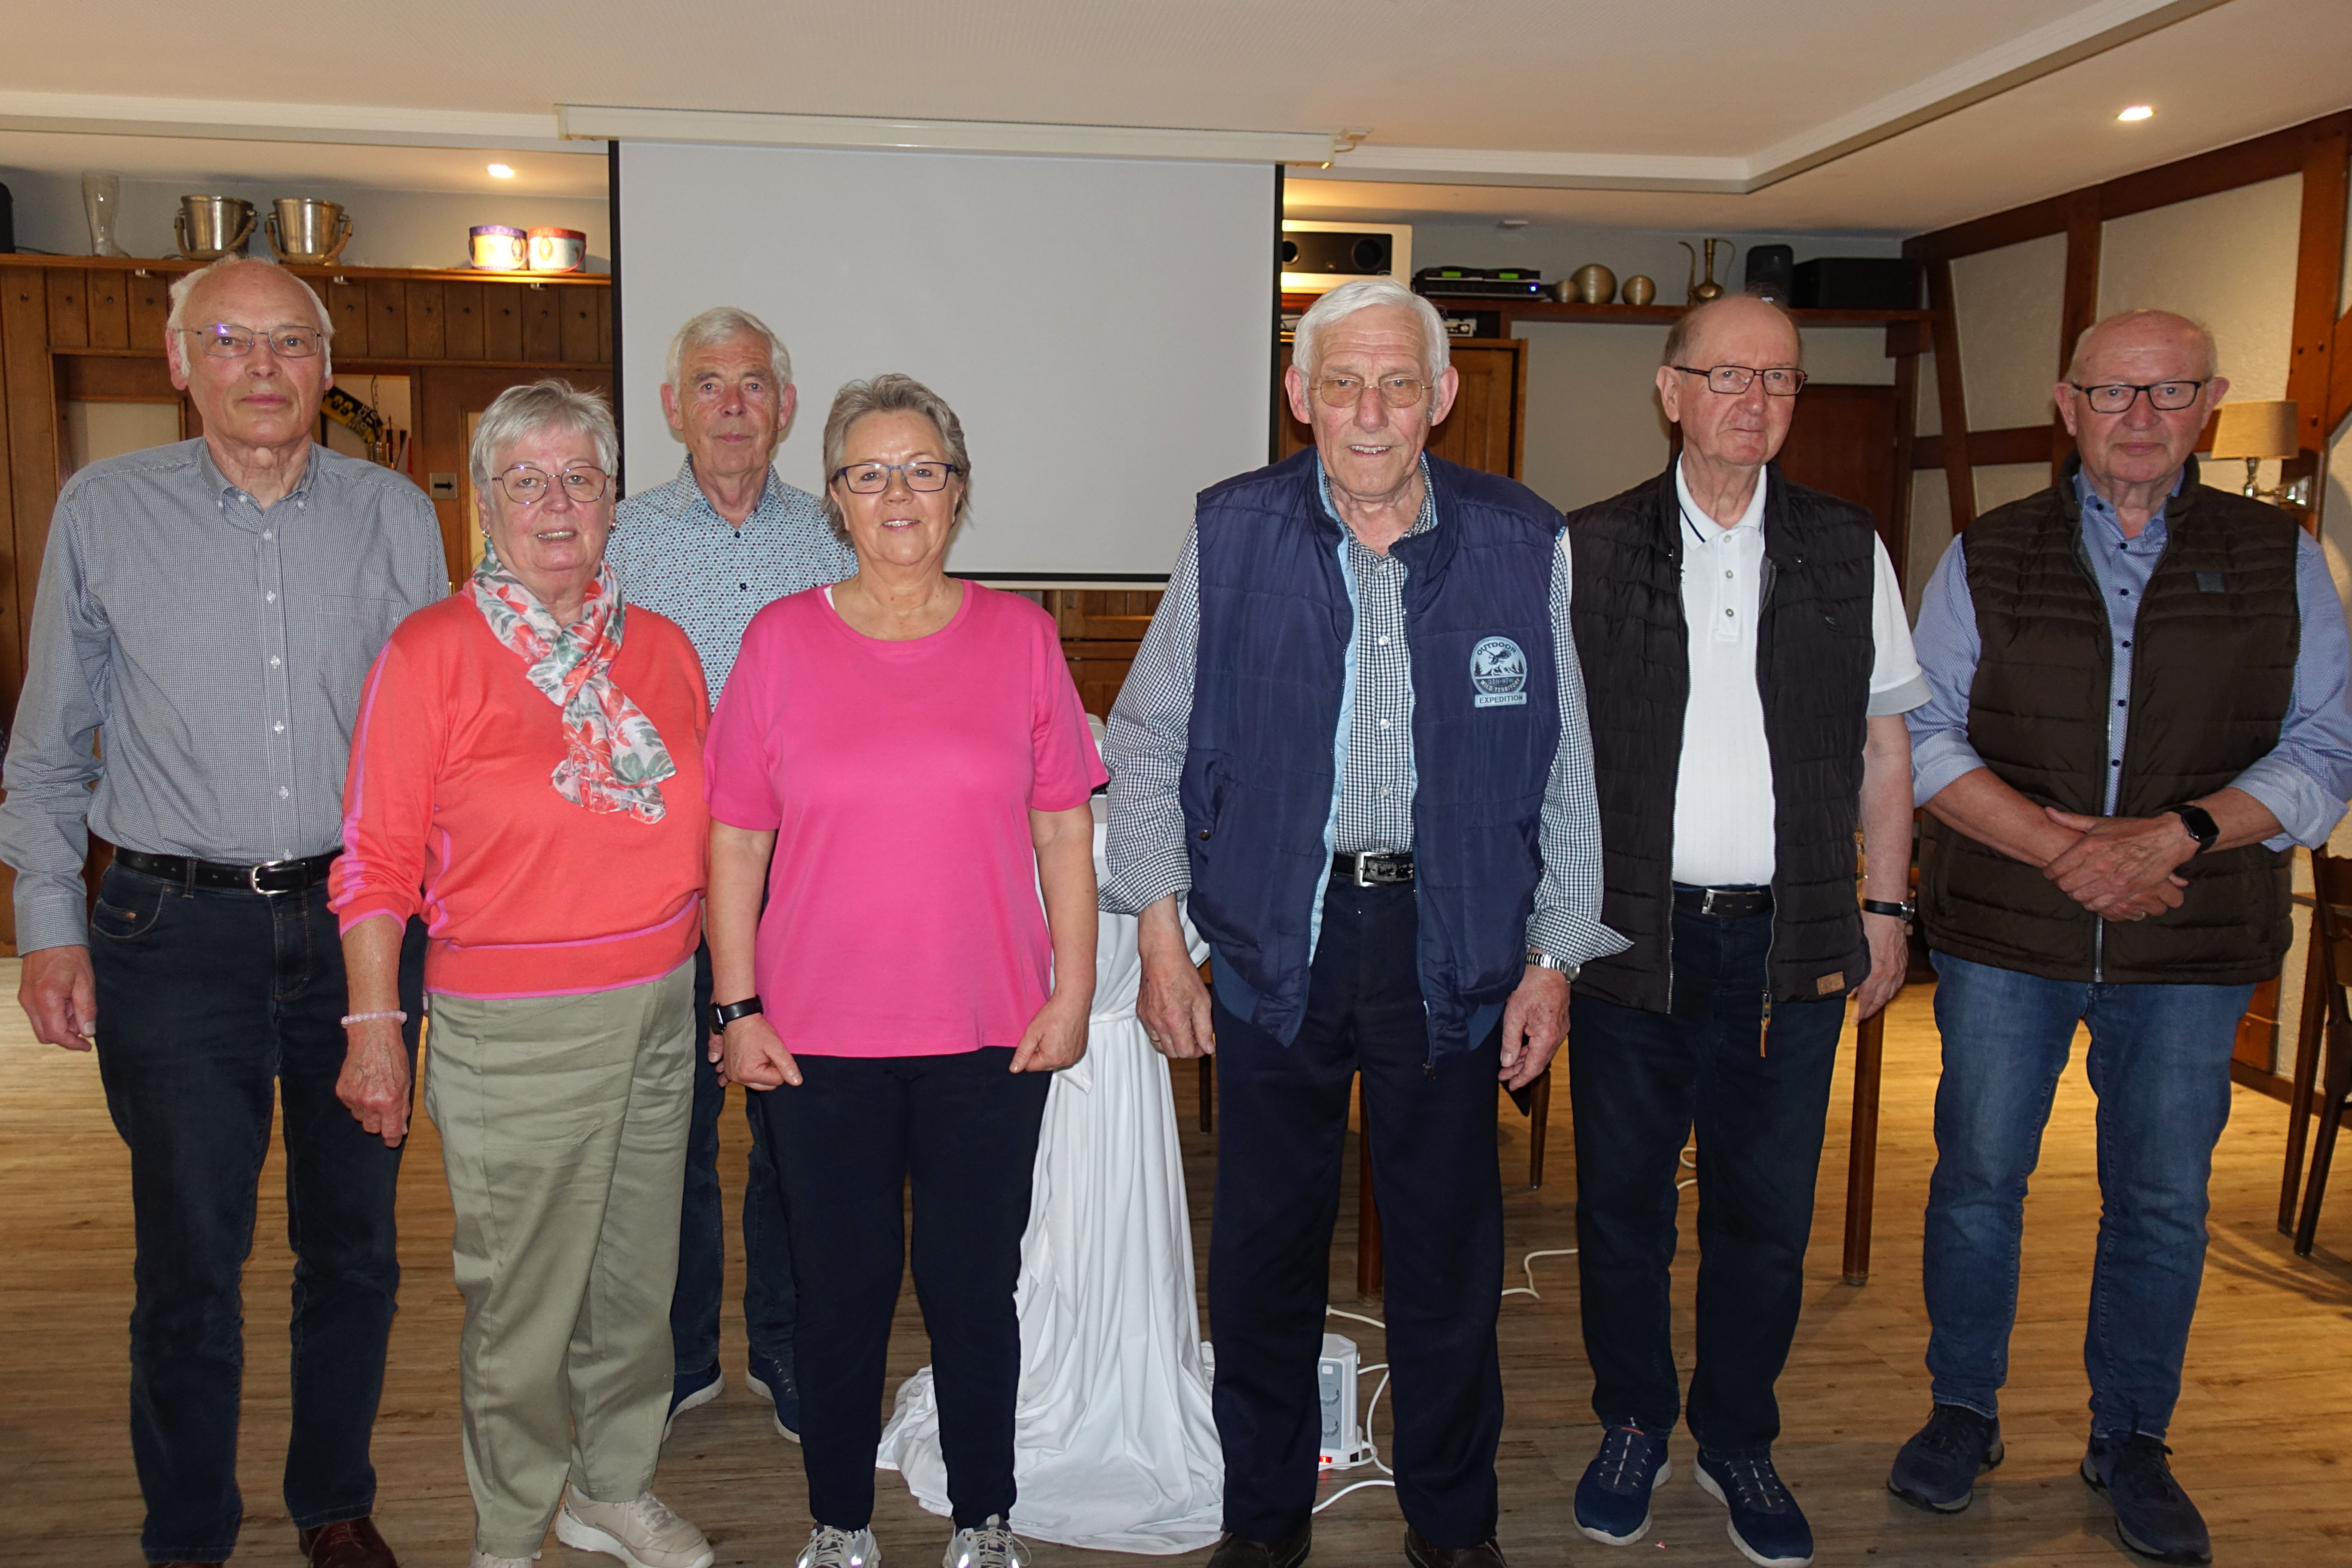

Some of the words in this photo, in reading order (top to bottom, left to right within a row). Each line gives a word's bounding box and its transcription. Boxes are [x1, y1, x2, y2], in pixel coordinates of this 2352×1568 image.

[1477, 642, 1516, 655] OUTDOOR
[1480, 680, 1493, 691] WILD
[1494, 677, 1520, 692] TERRITORY
[1479, 695, 1523, 704] EXPEDITION
